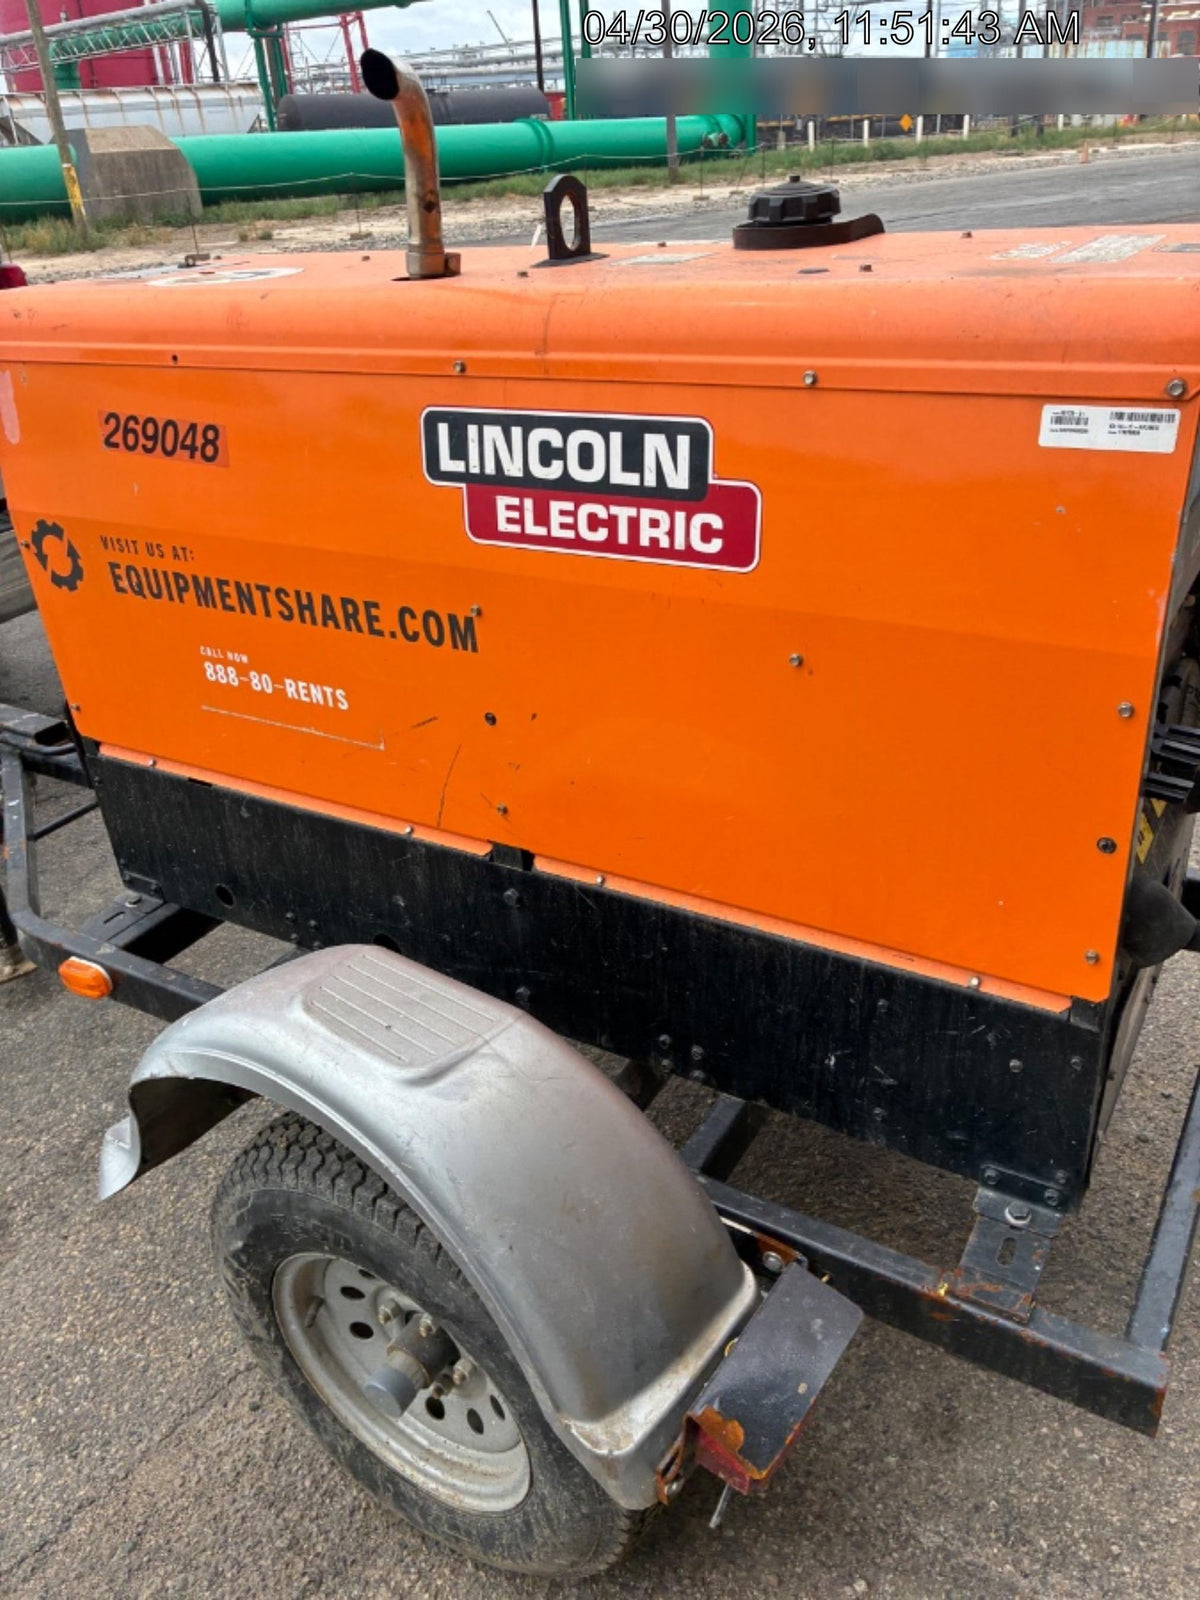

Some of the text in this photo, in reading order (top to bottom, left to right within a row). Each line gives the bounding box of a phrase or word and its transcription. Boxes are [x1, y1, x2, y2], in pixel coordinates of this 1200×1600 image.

[104, 412, 219, 462] 269048
[437, 422, 690, 490] LINCOLN
[100, 535, 194, 562] VISIT US AT:
[495, 495, 723, 554] ELECTRIC
[108, 561, 479, 653] EQUIPMENTSHARE.COM
[200, 645, 248, 664] CALL NOW
[204, 660, 349, 710] 888-80-RENTS
